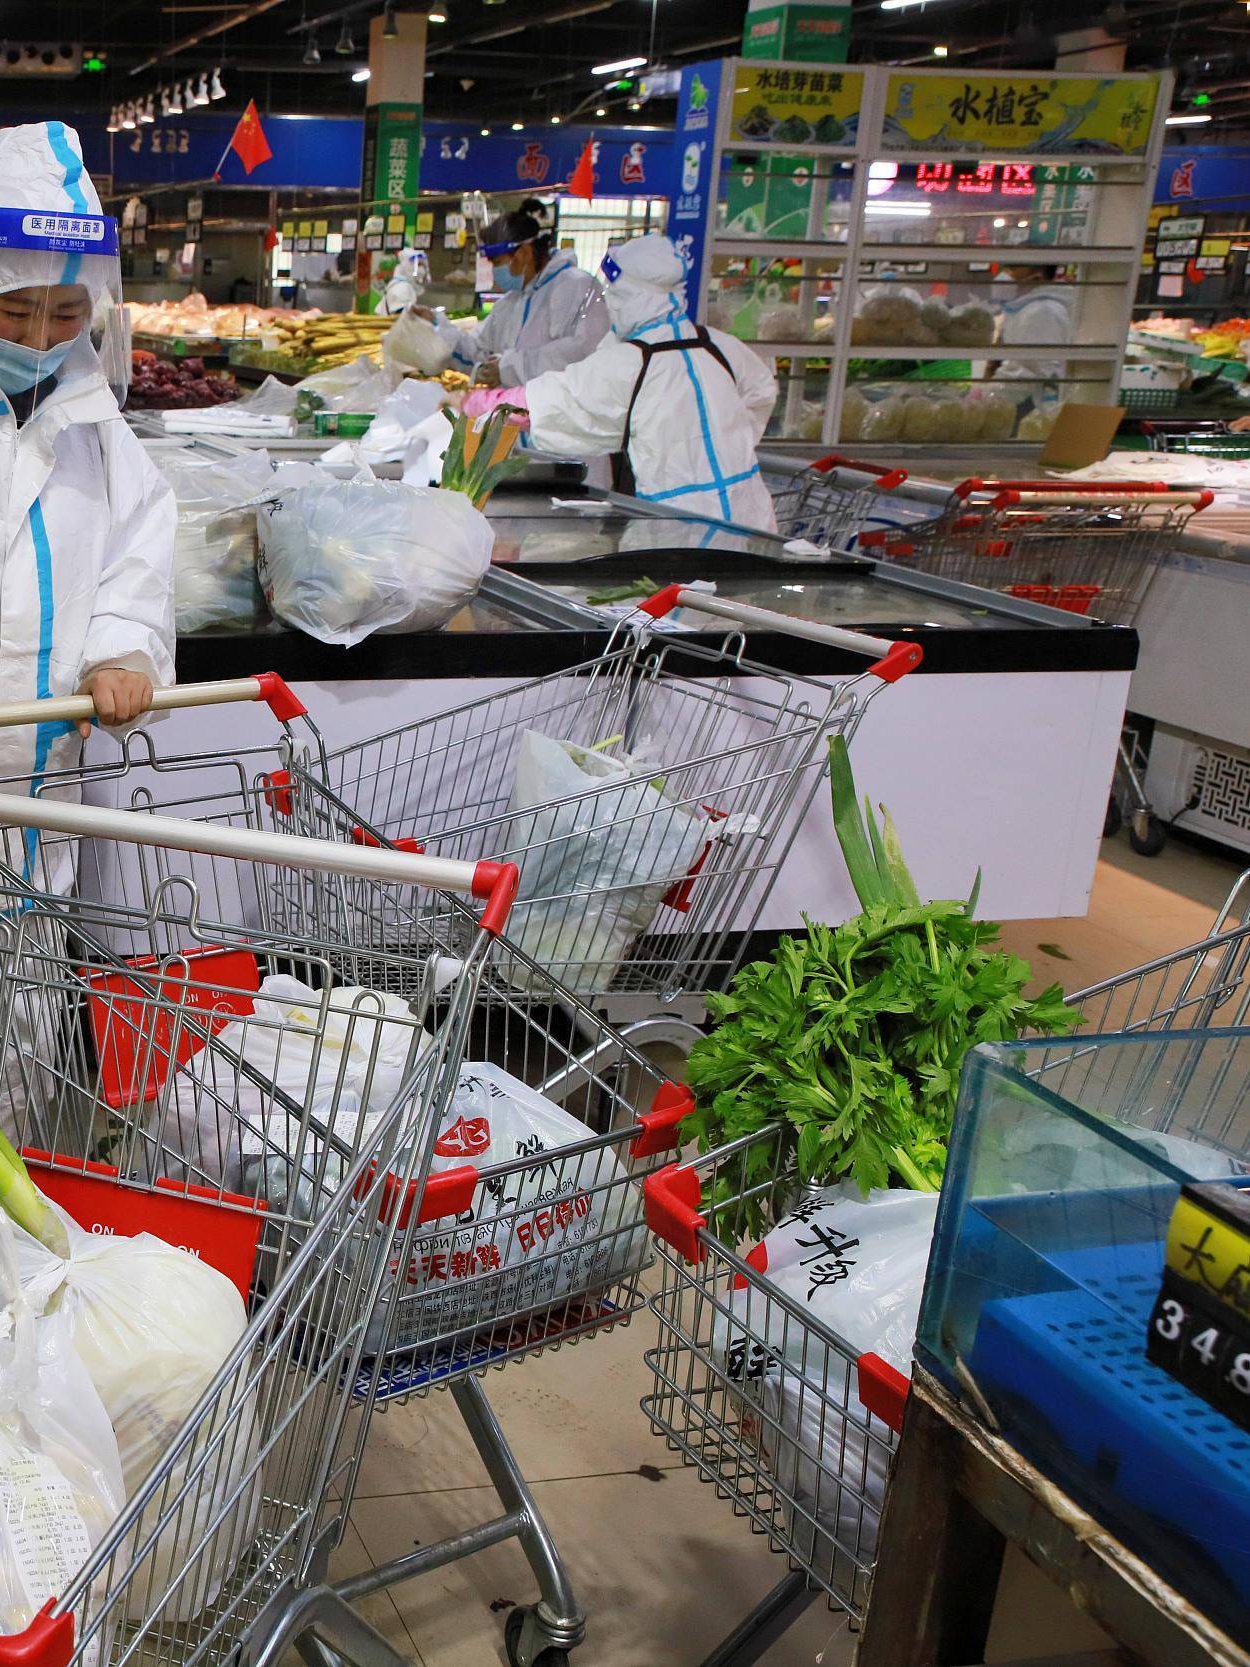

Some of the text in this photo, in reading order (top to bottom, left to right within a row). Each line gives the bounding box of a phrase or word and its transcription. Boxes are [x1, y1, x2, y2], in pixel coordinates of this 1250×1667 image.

[756, 69, 844, 93] 水培芽苗菜
[949, 84, 1049, 126] 水植宝
[387, 137, 409, 199] 蔬菜区
[31, 217, 100, 234] 医用隔离面罩
[91, 1223, 115, 1236] ON
[390, 1243, 501, 1285] 天天新鲜
[516, 1186, 592, 1252] 日日特价
